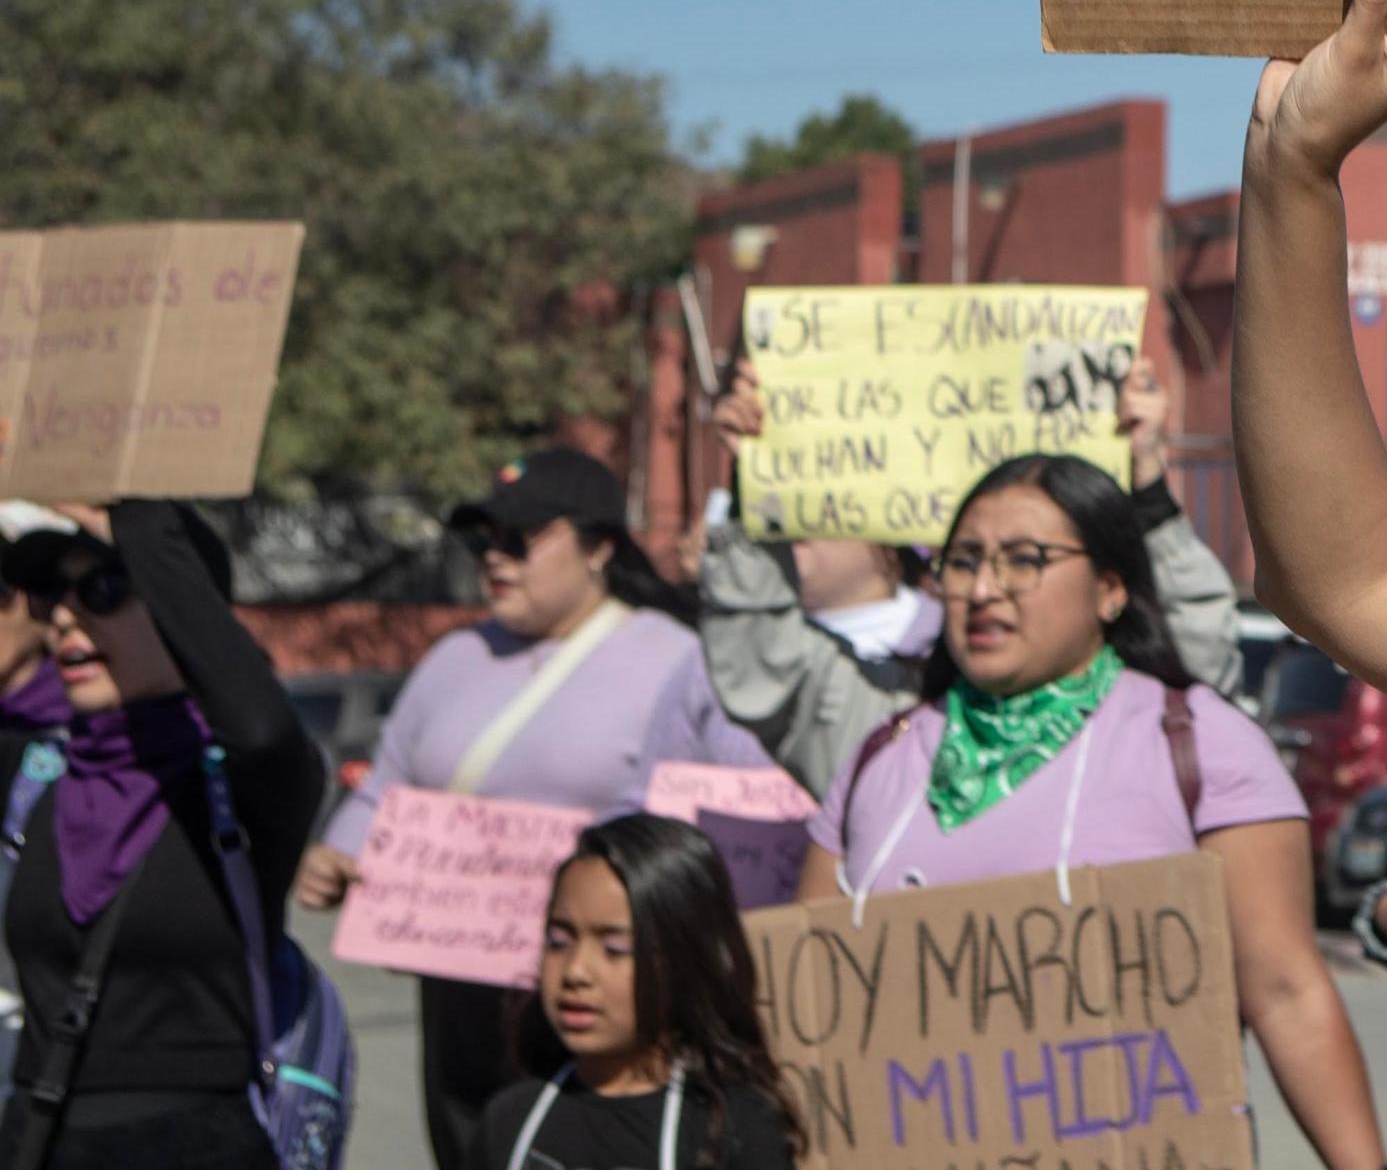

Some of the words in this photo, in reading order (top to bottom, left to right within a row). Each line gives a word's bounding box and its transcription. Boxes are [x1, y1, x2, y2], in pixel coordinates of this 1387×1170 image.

[213, 244, 281, 306] de
[836, 378, 903, 420] LAS
[929, 375, 1010, 419] QUE
[914, 428, 941, 477] Y
[794, 490, 868, 535] LAS
[754, 919, 889, 1056] HOY
[917, 905, 1201, 1040] MARCHO
[781, 1059, 856, 1155] ON
[887, 1051, 979, 1147] MI
[1003, 1029, 1200, 1146] HIJA
